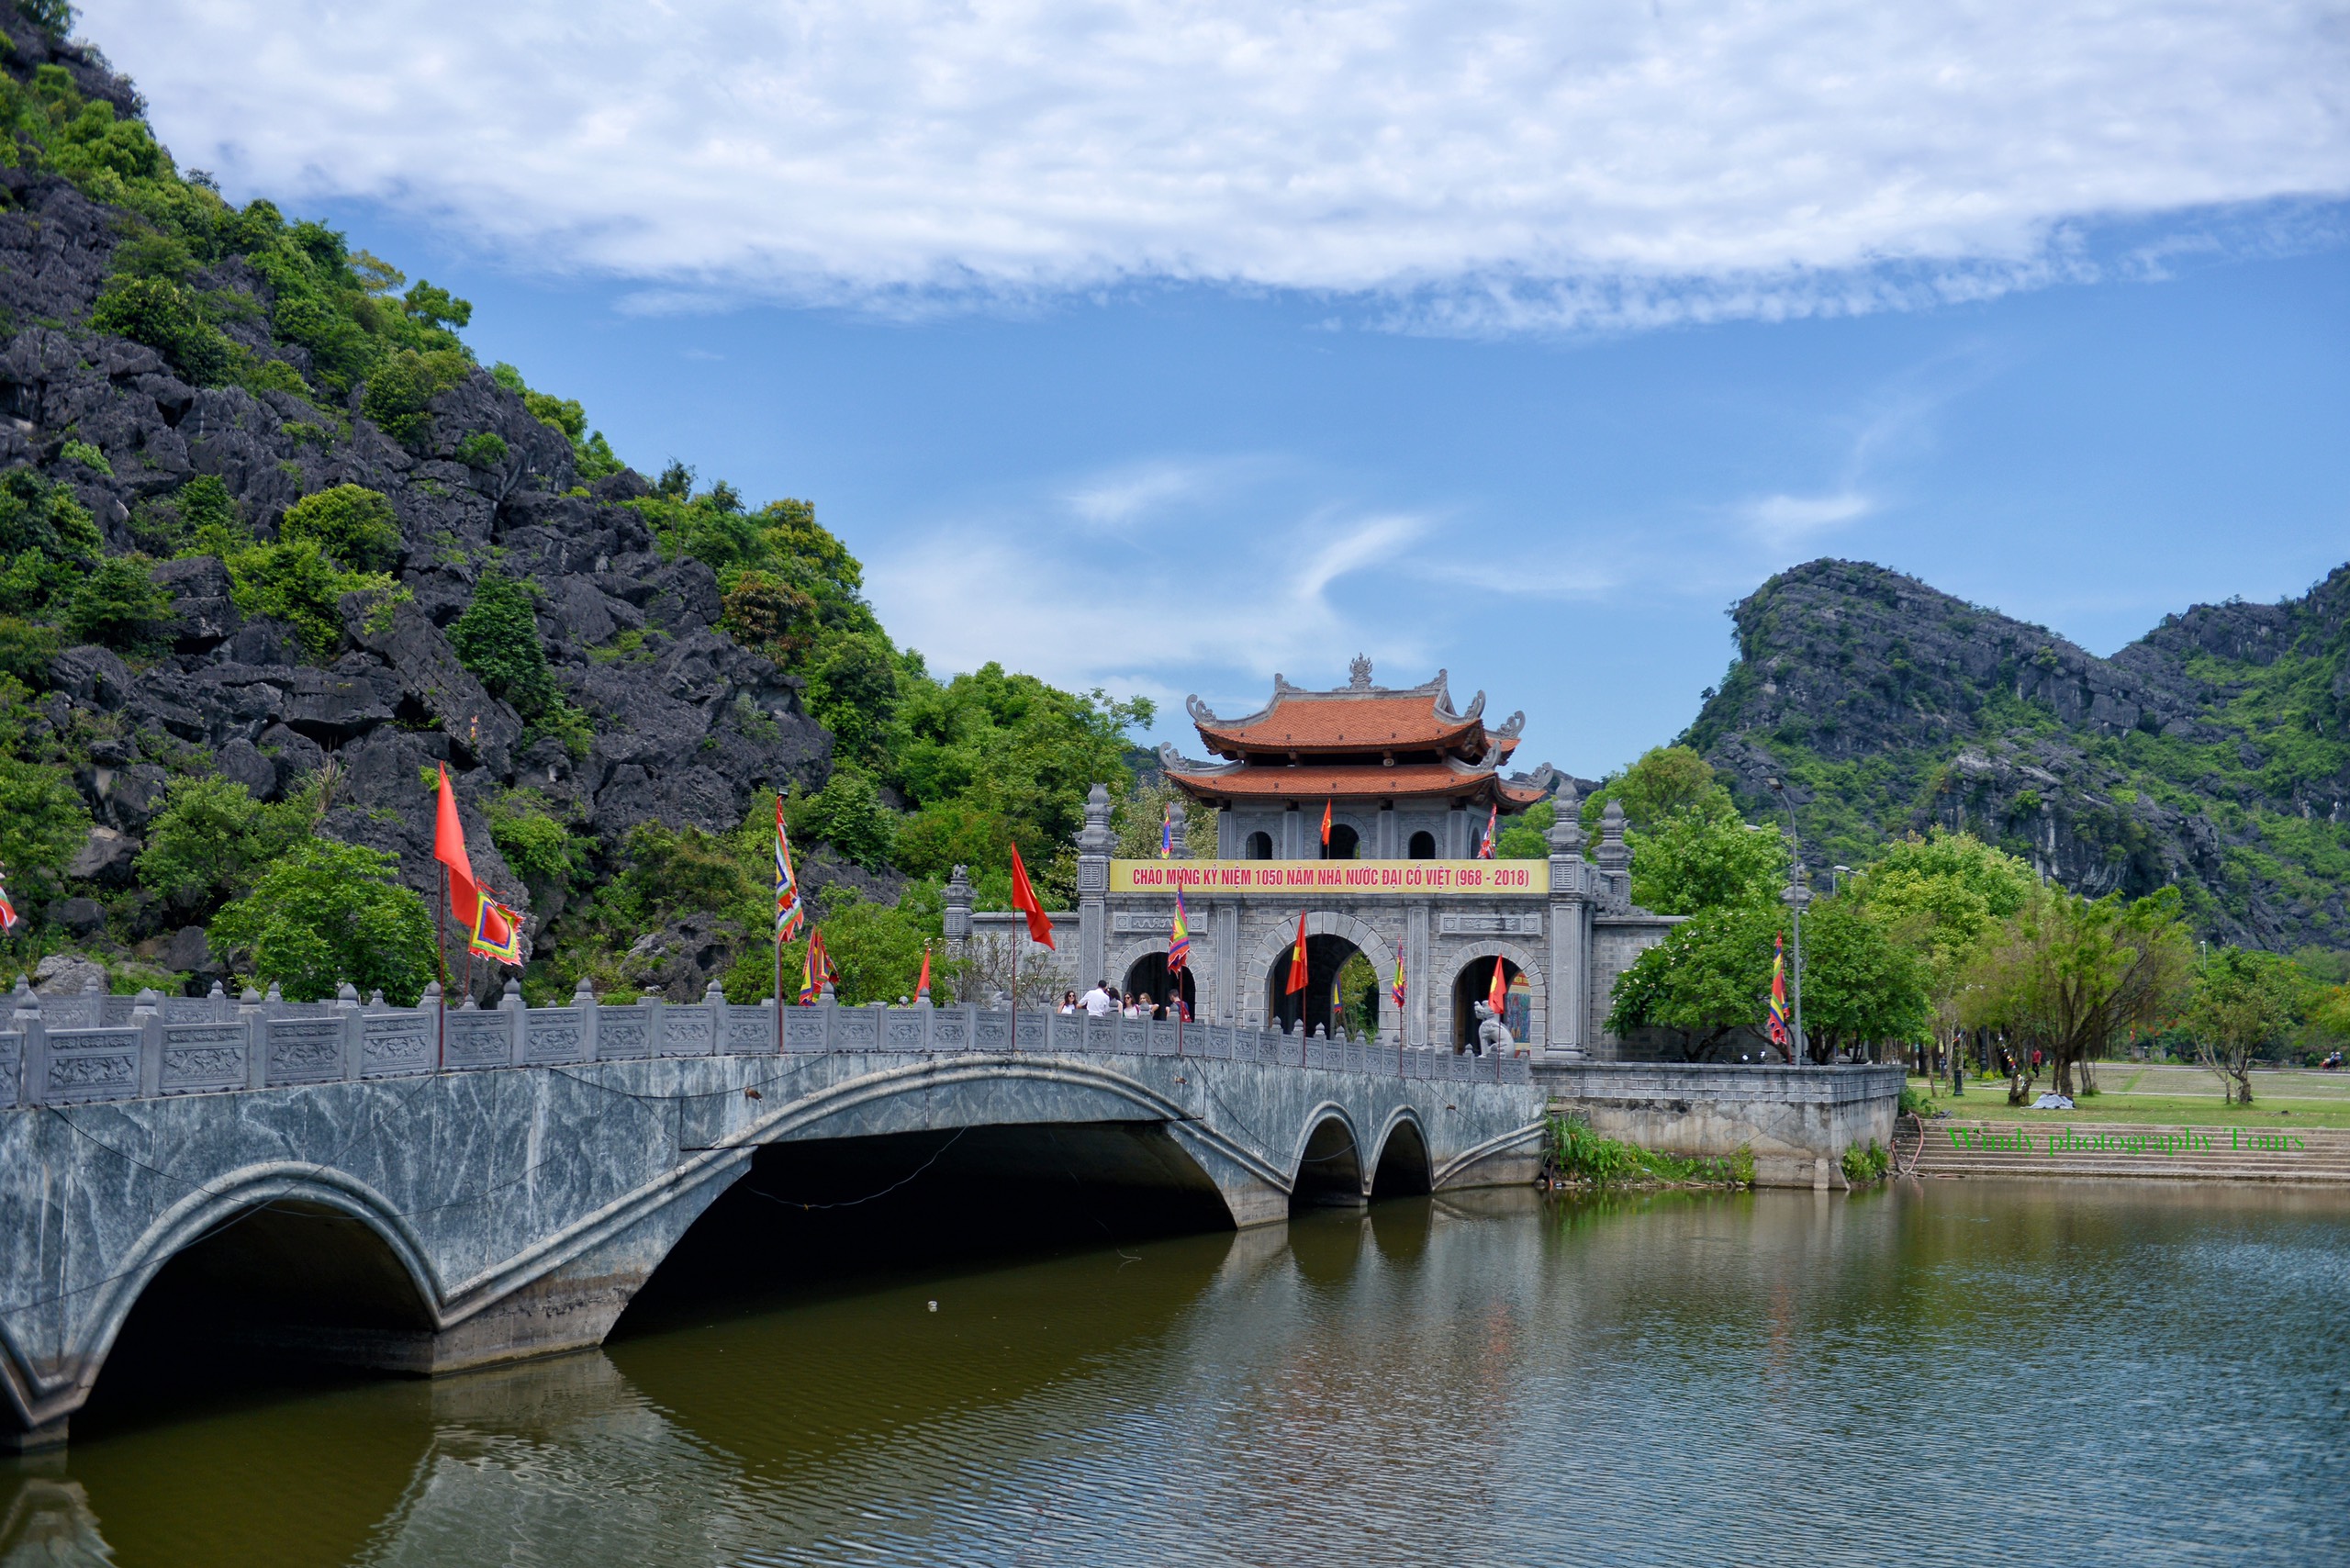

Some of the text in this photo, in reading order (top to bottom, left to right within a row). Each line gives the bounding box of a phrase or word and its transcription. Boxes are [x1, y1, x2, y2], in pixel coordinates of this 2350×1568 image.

[1133, 866, 1163, 885] CHÀO
[1166, 866, 1201, 885] MỪNG
[1203, 863, 1218, 885] KỶ
[1221, 866, 1252, 889] NIỆM
[1255, 868, 1283, 886] 1050
[1287, 866, 1315, 885] NĂM
[1317, 866, 1342, 885] NHÀ
[1346, 866, 1379, 886] NƯỚC
[1382, 868, 1404, 889] ĐẠI
[1405, 863, 1423, 885] CỔ
[1426, 866, 1452, 889] VIỆT
[1456, 868, 1483, 887] (968
[1494, 868, 1530, 887] 2018)
